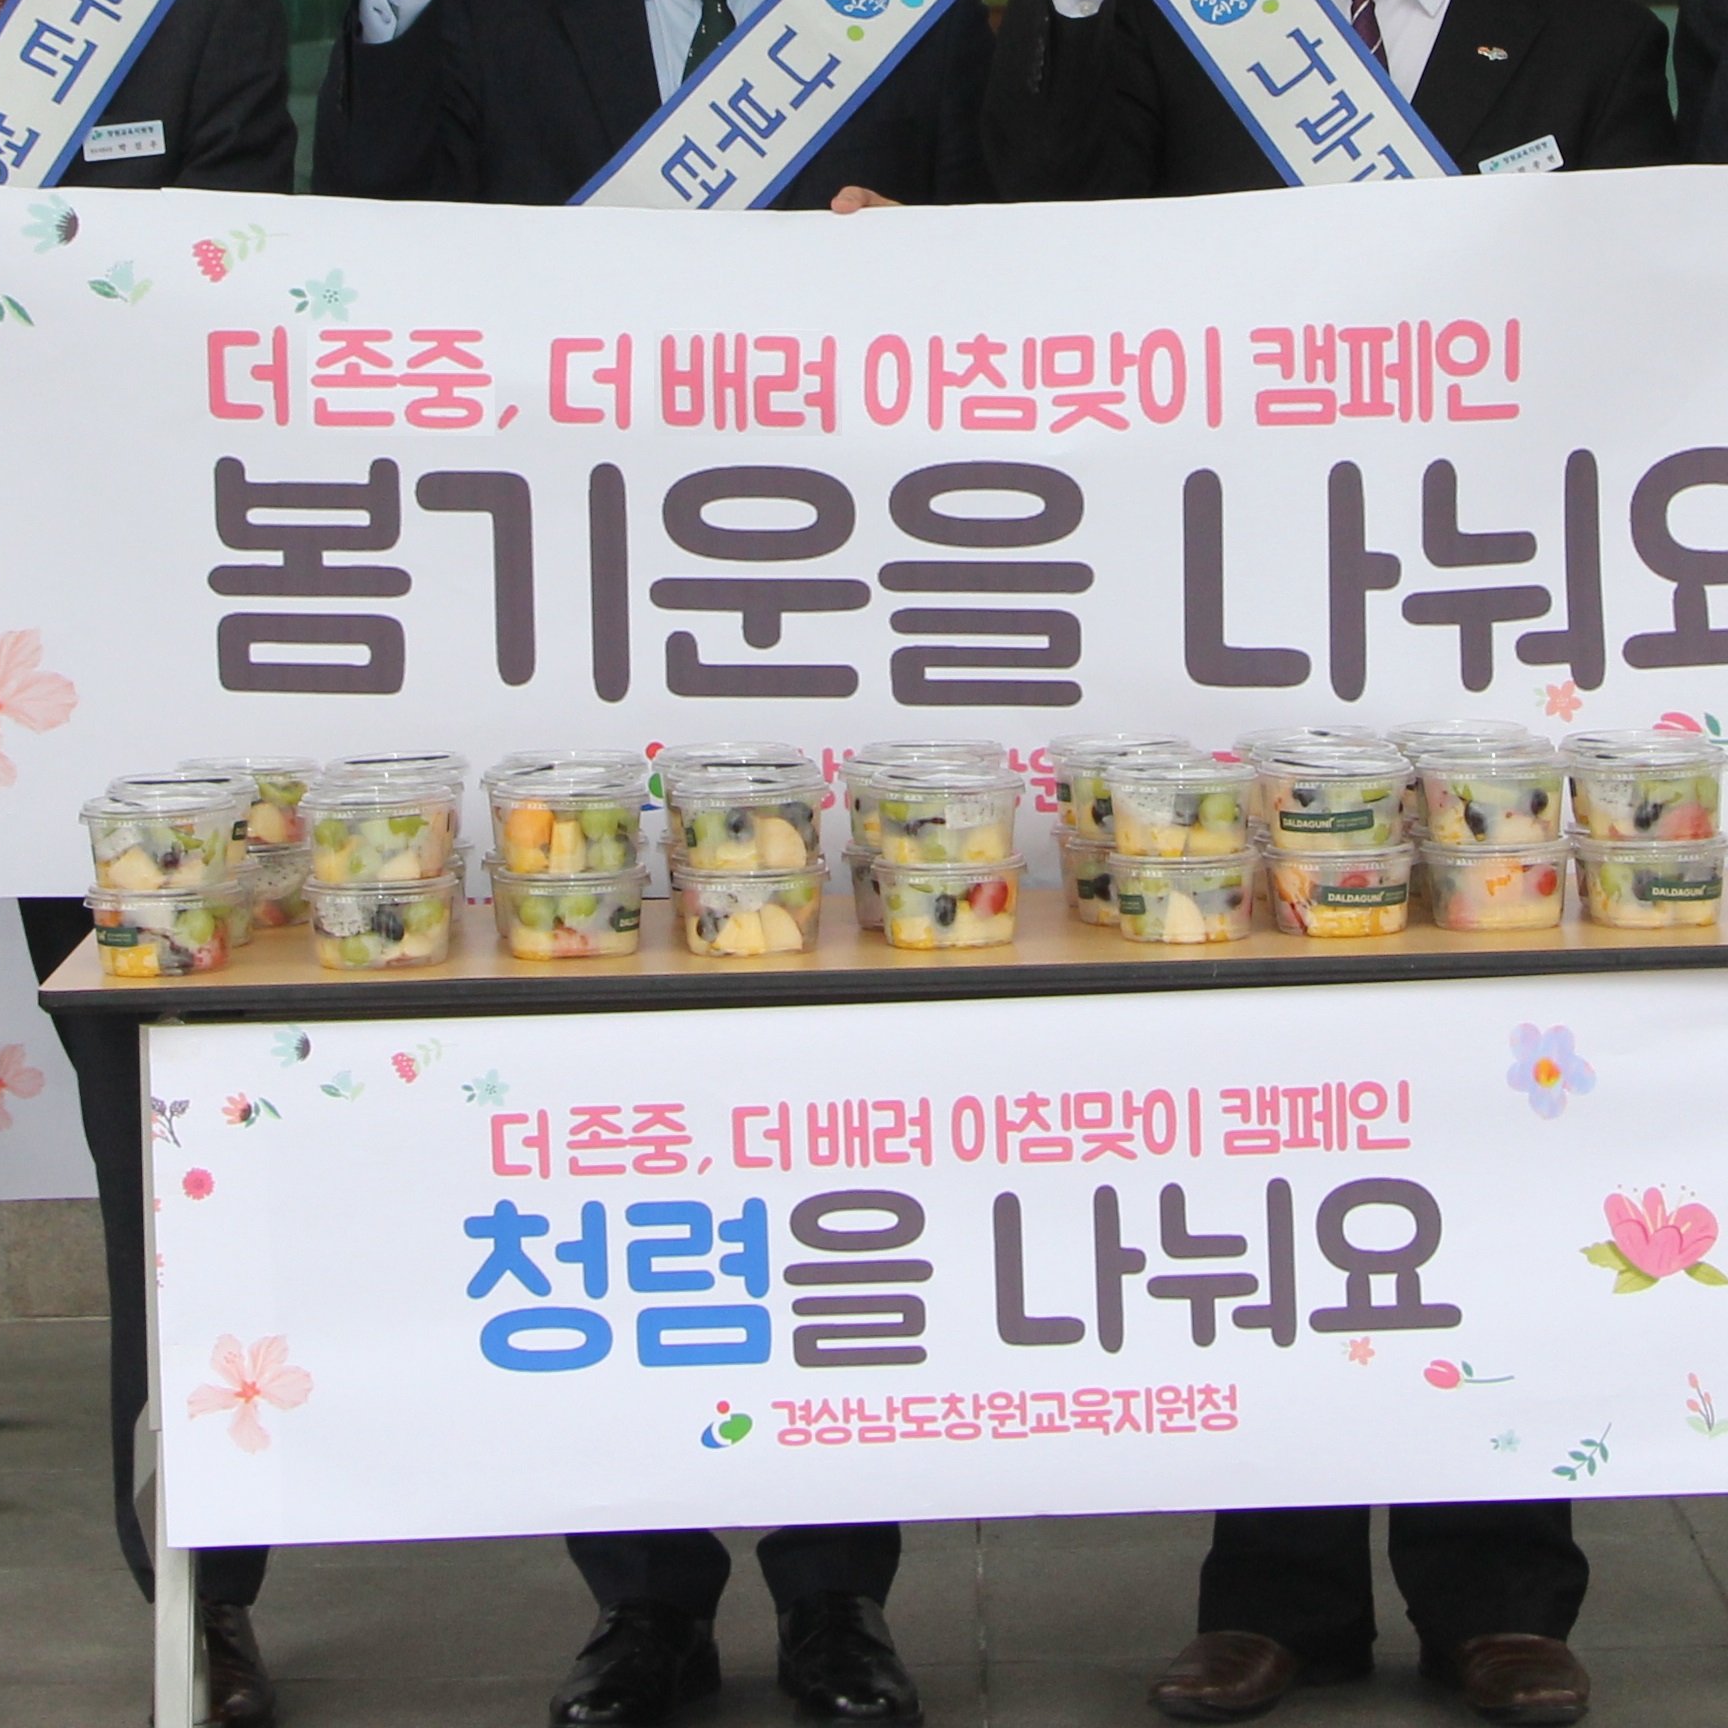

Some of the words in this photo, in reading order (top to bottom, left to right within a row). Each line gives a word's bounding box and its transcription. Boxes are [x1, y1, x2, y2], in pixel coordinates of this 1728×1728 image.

[209, 327, 290, 425] 더
[312, 328, 519, 430] 존중,
[550, 332, 633, 429] 더
[662, 332, 837, 432] 배려
[864, 326, 1223, 432] 아침맞이
[1250, 319, 1520, 425] 캠페인
[208, 456, 1094, 707] 봄기운을
[491, 1108, 551, 1179] 더
[567, 1101, 712, 1177] 존중,
[732, 1101, 792, 1171] 더
[807, 1096, 933, 1168] 배려
[952, 1086, 1203, 1164] 아침맞이
[1220, 1079, 1412, 1156] 캠페인
[464, 1190, 933, 1374] 청렴을
[992, 1177, 1462, 1355] 나눠요
[771, 1383, 1239, 1447] 경상남도창원교육지원청
